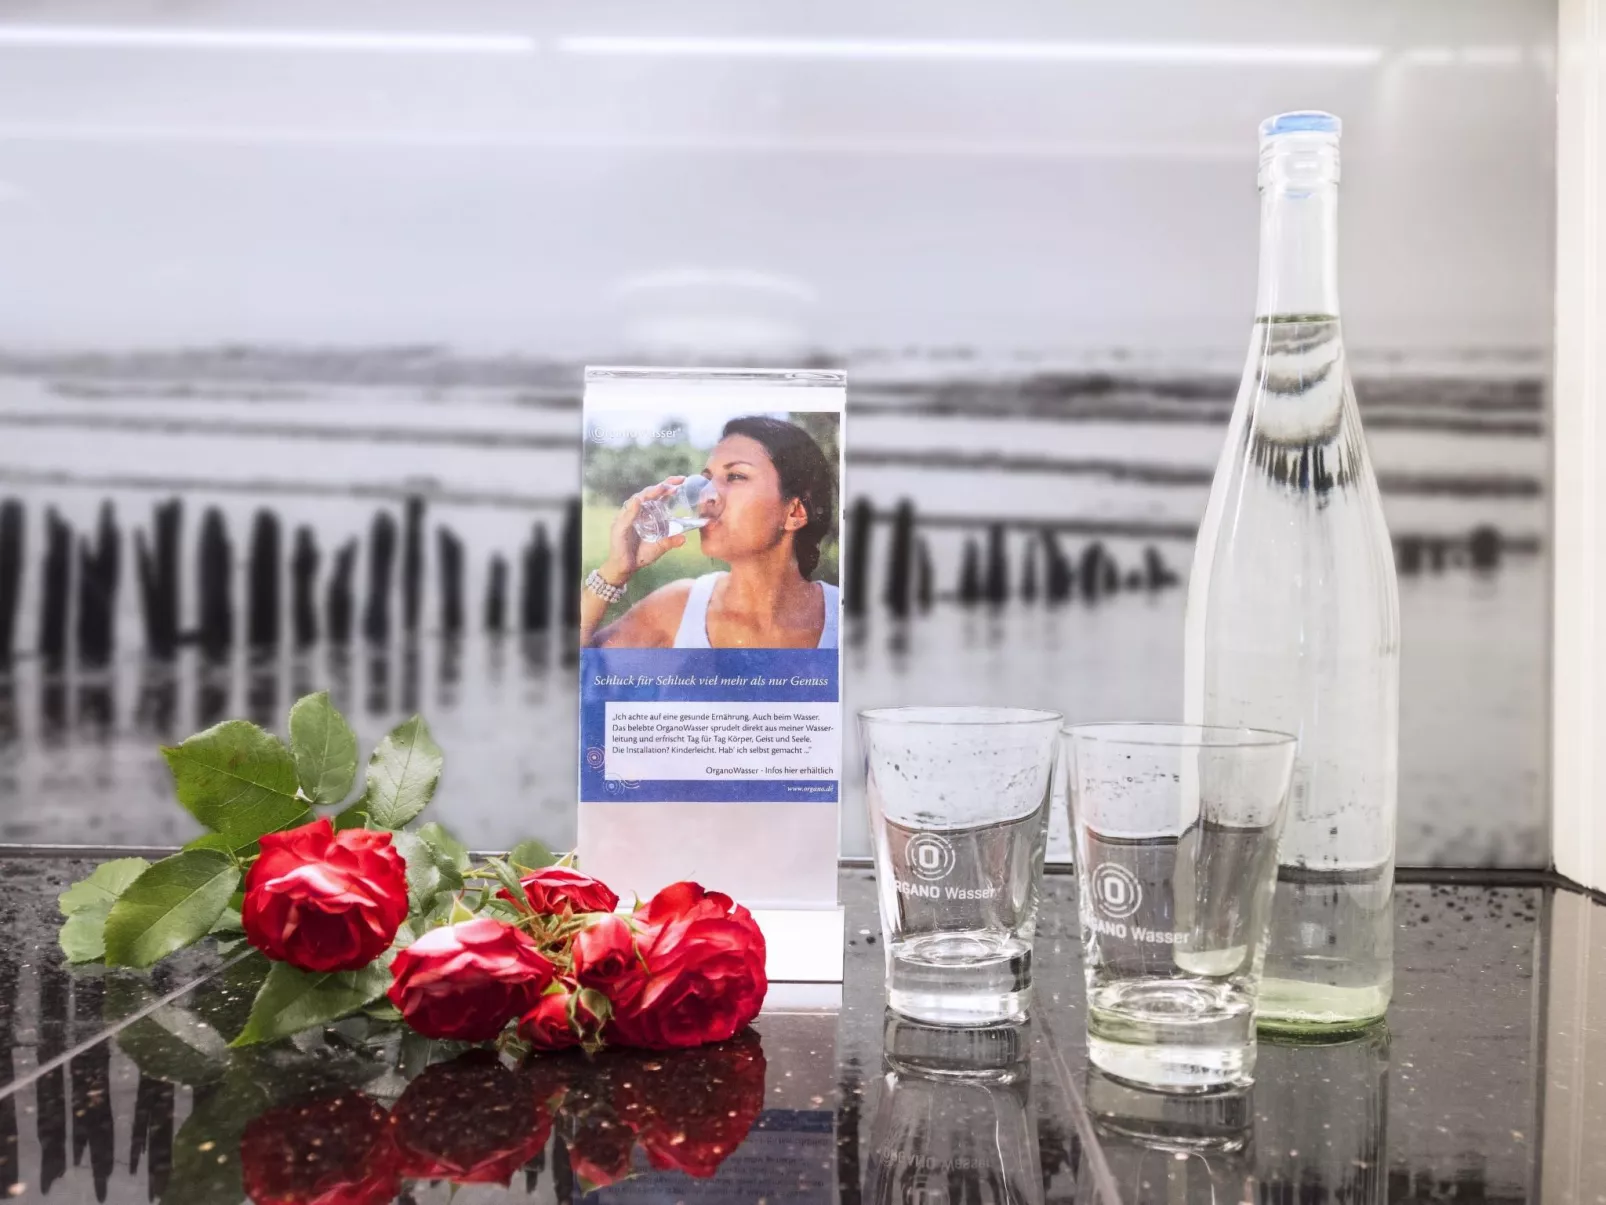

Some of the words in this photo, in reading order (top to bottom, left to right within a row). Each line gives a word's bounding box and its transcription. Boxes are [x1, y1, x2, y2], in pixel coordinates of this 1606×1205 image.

[594, 675, 634, 686] Schluck
[635, 675, 653, 688] für
[656, 675, 696, 686] Schluck
[700, 675, 718, 686] viel
[721, 676, 748, 686] mehr
[750, 676, 765, 686] als
[769, 678, 787, 686] nur
[790, 676, 828, 686] Genuss
[680, 714, 710, 722] gesunde
[656, 724, 709, 733] OrganoWasser
[710, 724, 740, 733] sprudelt
[612, 735, 637, 744] leitung
[687, 735, 699, 744] Tag
[714, 736, 726, 744] Tag
[771, 747, 802, 755] gemacht
[706, 767, 758, 775] OrganoWasser
[944, 886, 996, 900] Wasser
[1130, 926, 1191, 944] Wasser
